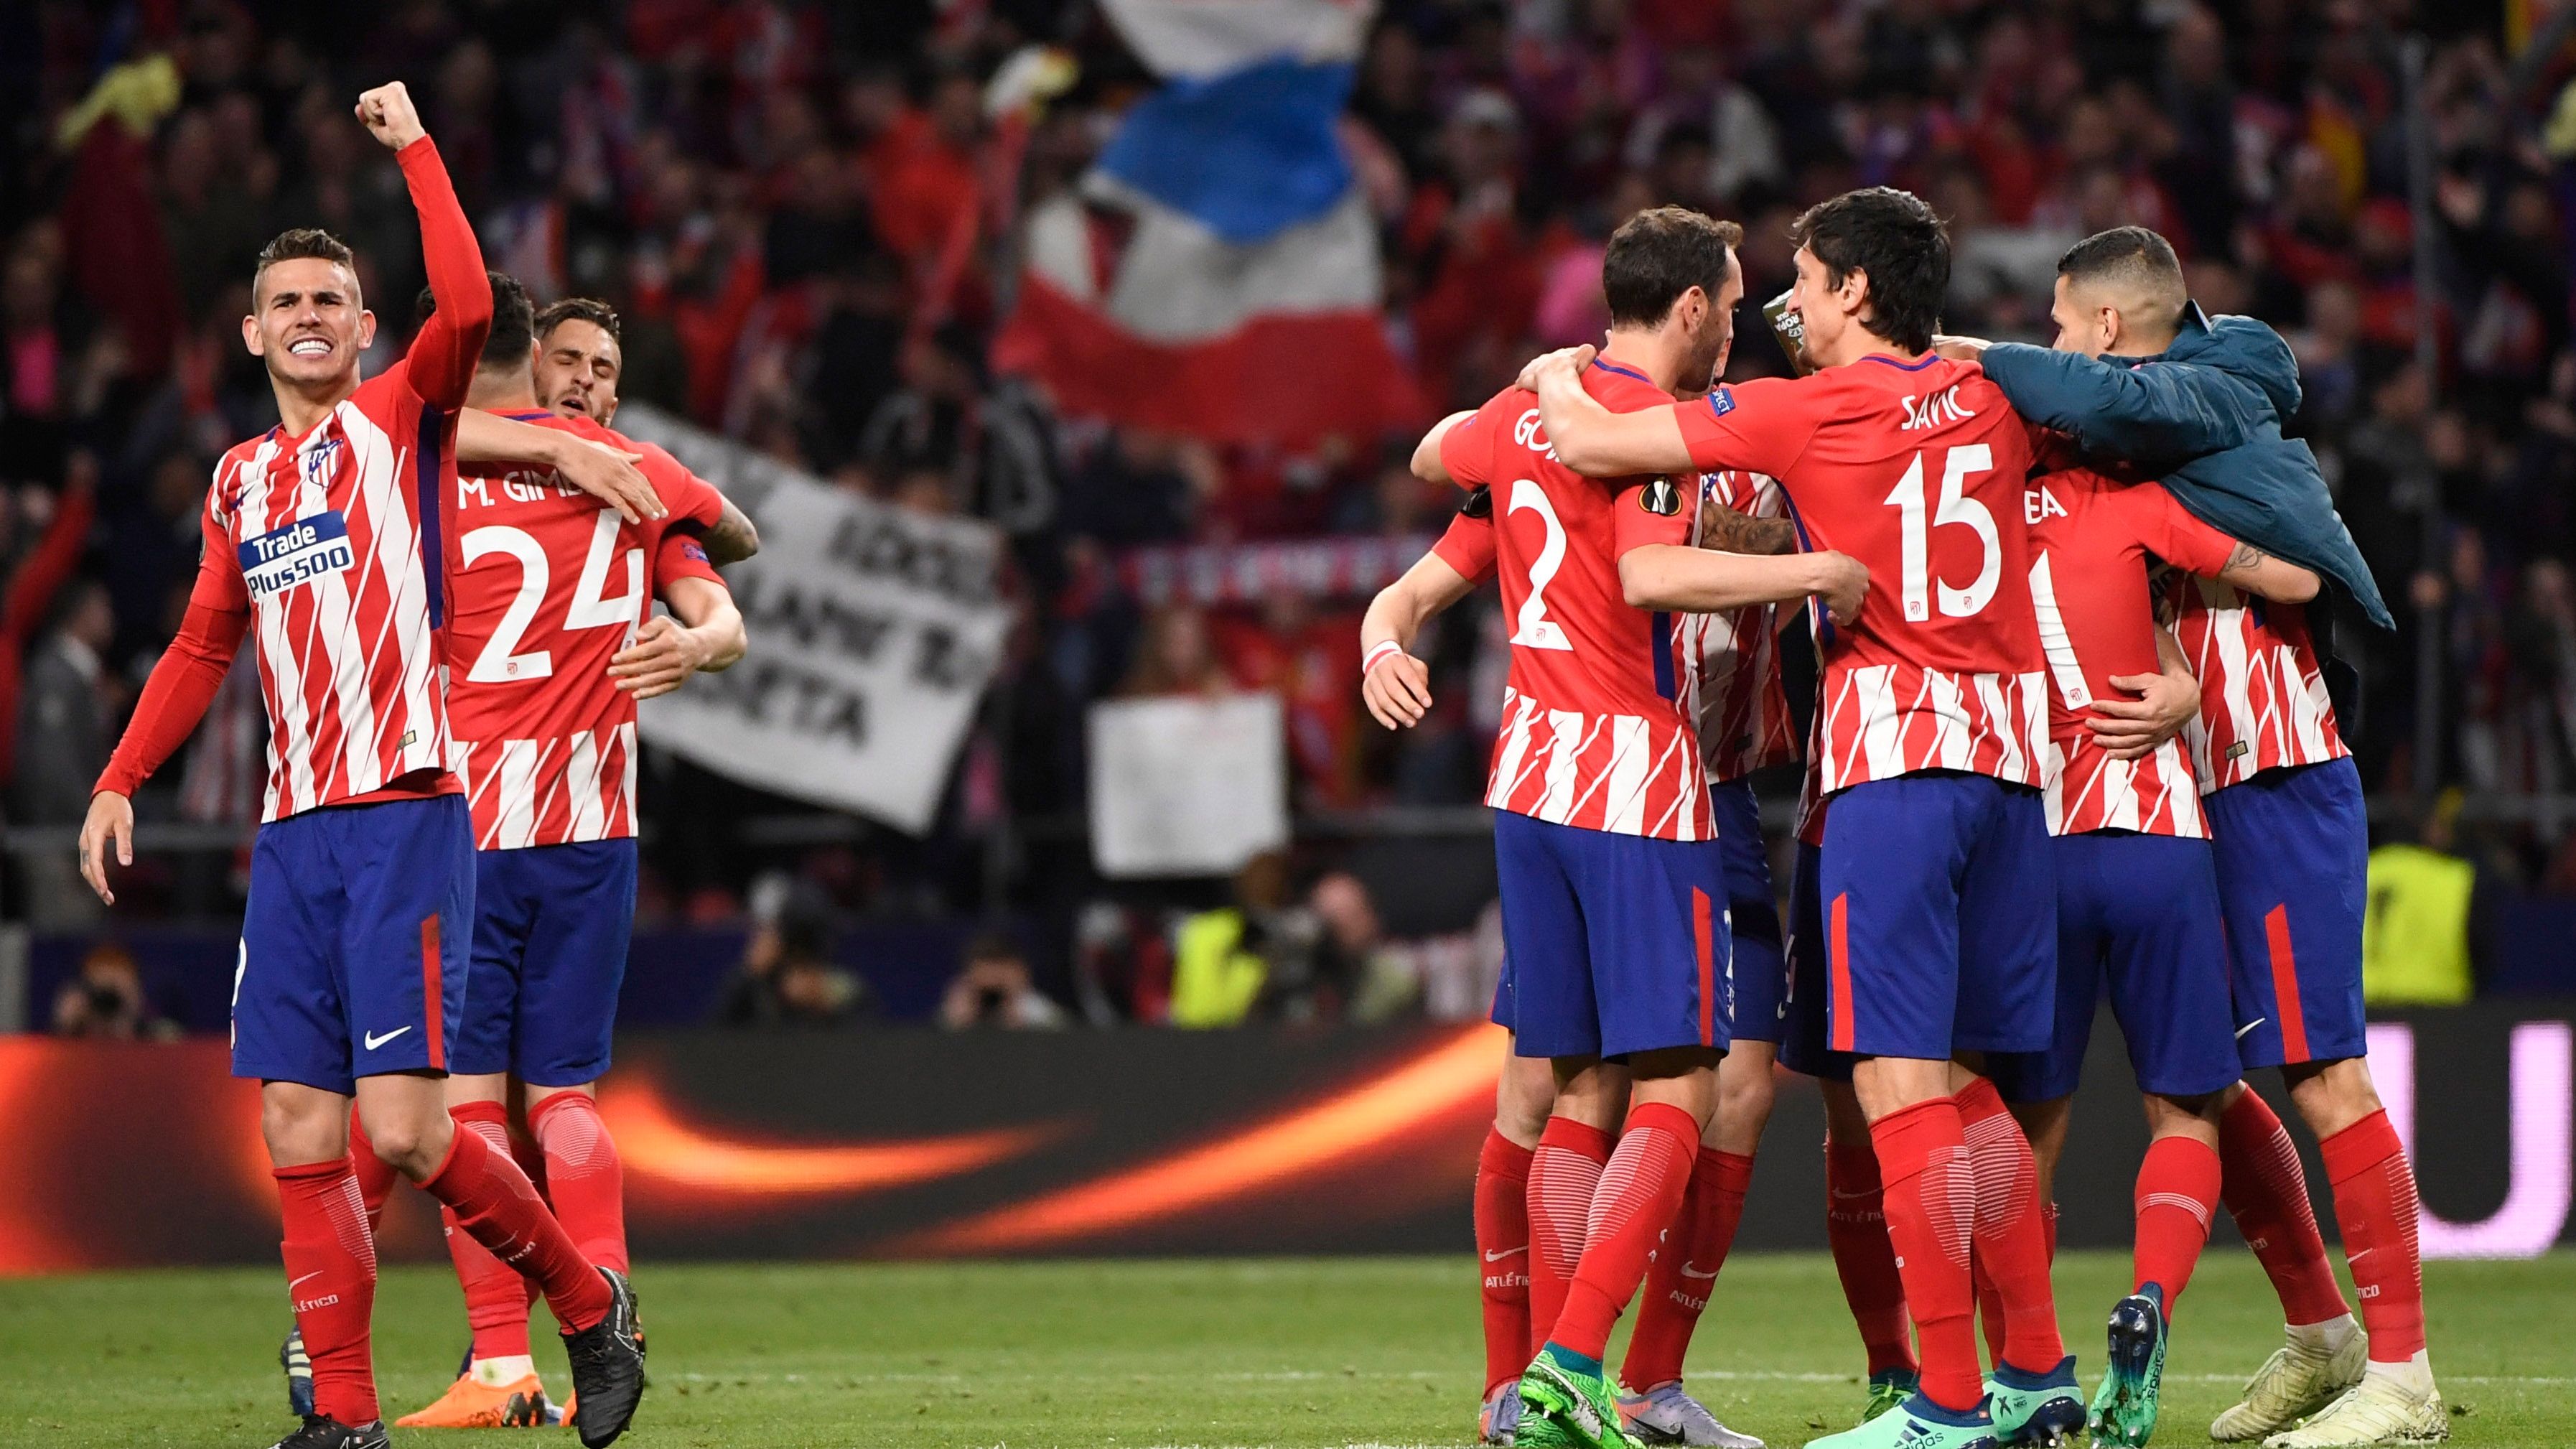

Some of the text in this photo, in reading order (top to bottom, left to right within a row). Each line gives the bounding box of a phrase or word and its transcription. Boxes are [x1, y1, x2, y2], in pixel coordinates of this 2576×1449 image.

[457, 473, 495, 510] M.
[1514, 408, 1560, 463] GO
[248, 546, 350, 599] Plus500
[252, 523, 317, 563] Trade
[1508, 479, 1574, 651] 2
[1883, 443, 2002, 622] 15
[460, 508, 645, 683] 24
[2366, 1020, 2572, 1260] U
